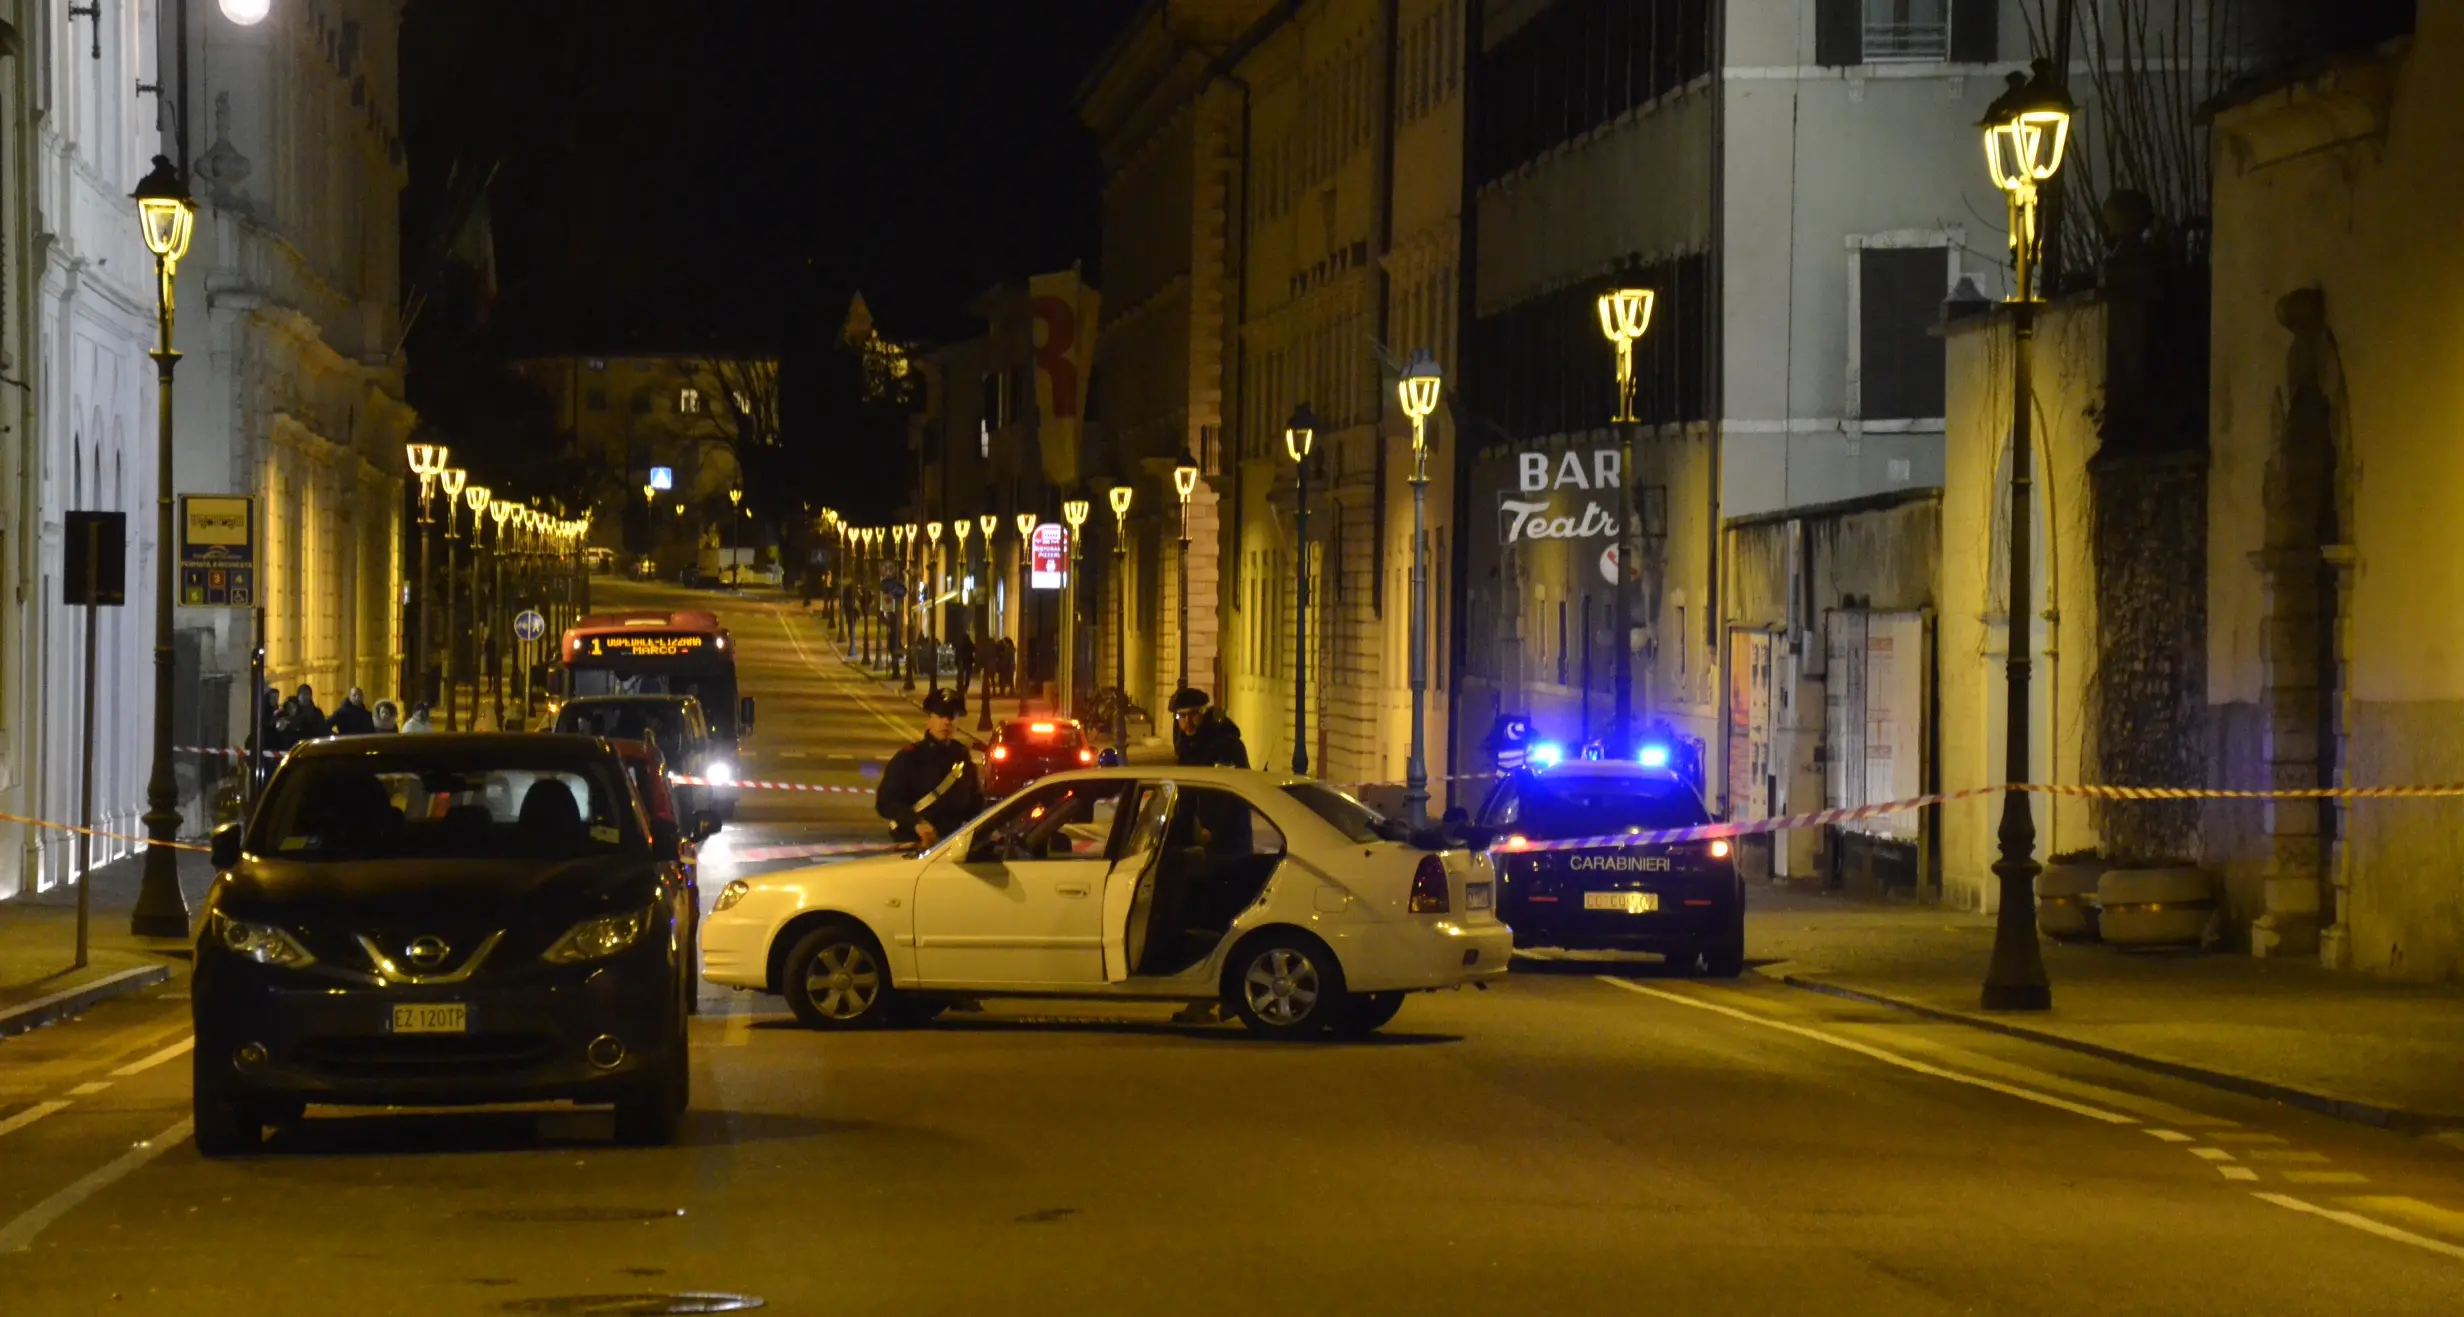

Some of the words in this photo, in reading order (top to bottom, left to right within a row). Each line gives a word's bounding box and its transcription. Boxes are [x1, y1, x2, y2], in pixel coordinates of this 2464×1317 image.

[1519, 449, 1621, 492] BAR
[1501, 499, 1620, 543] Teatr
[591, 638, 602, 656] 1
[632, 646, 677, 655] MARCO
[1570, 855, 1671, 872] CARABINIERI
[394, 1009, 413, 1028] EZ
[420, 1008, 465, 1028] 120TP
